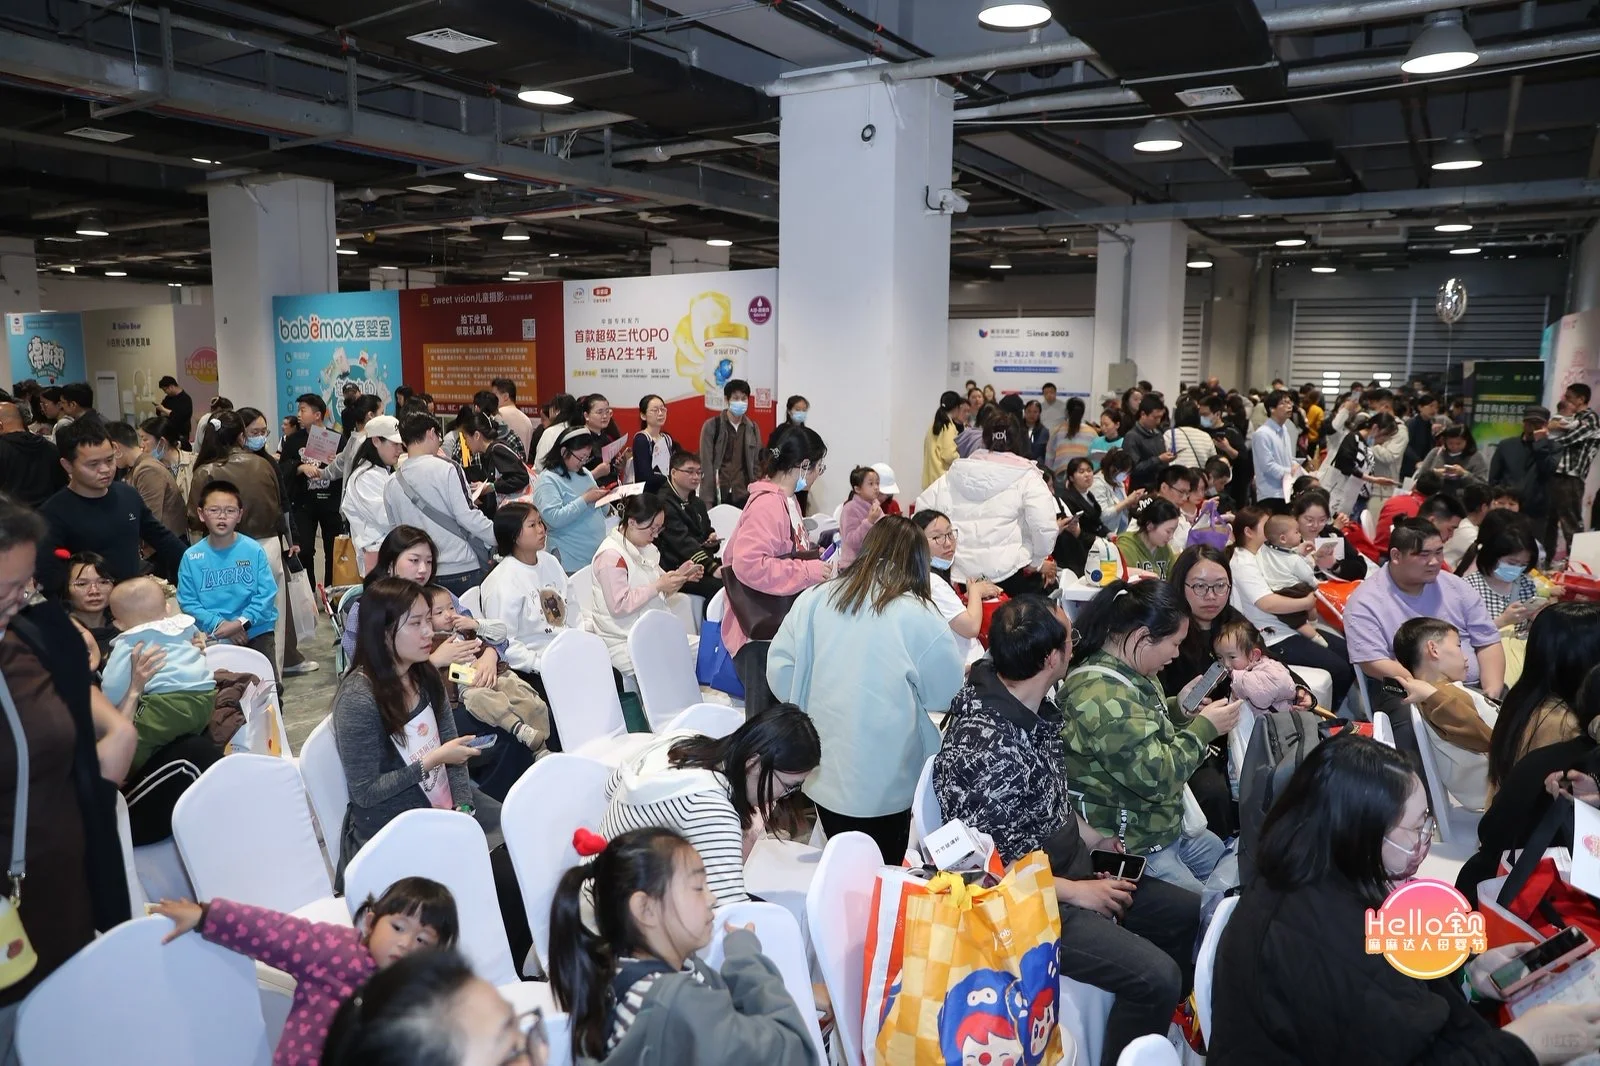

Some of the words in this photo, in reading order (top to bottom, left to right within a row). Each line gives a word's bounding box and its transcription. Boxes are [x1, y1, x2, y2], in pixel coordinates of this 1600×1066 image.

[432, 296, 453, 304] sweet
[574, 327, 670, 344] 首款超级三代OPO
[1026, 329, 1050, 337] Since
[585, 346, 658, 361] 鲜活A2生牛乳
[200, 566, 254, 592] LAKERS
